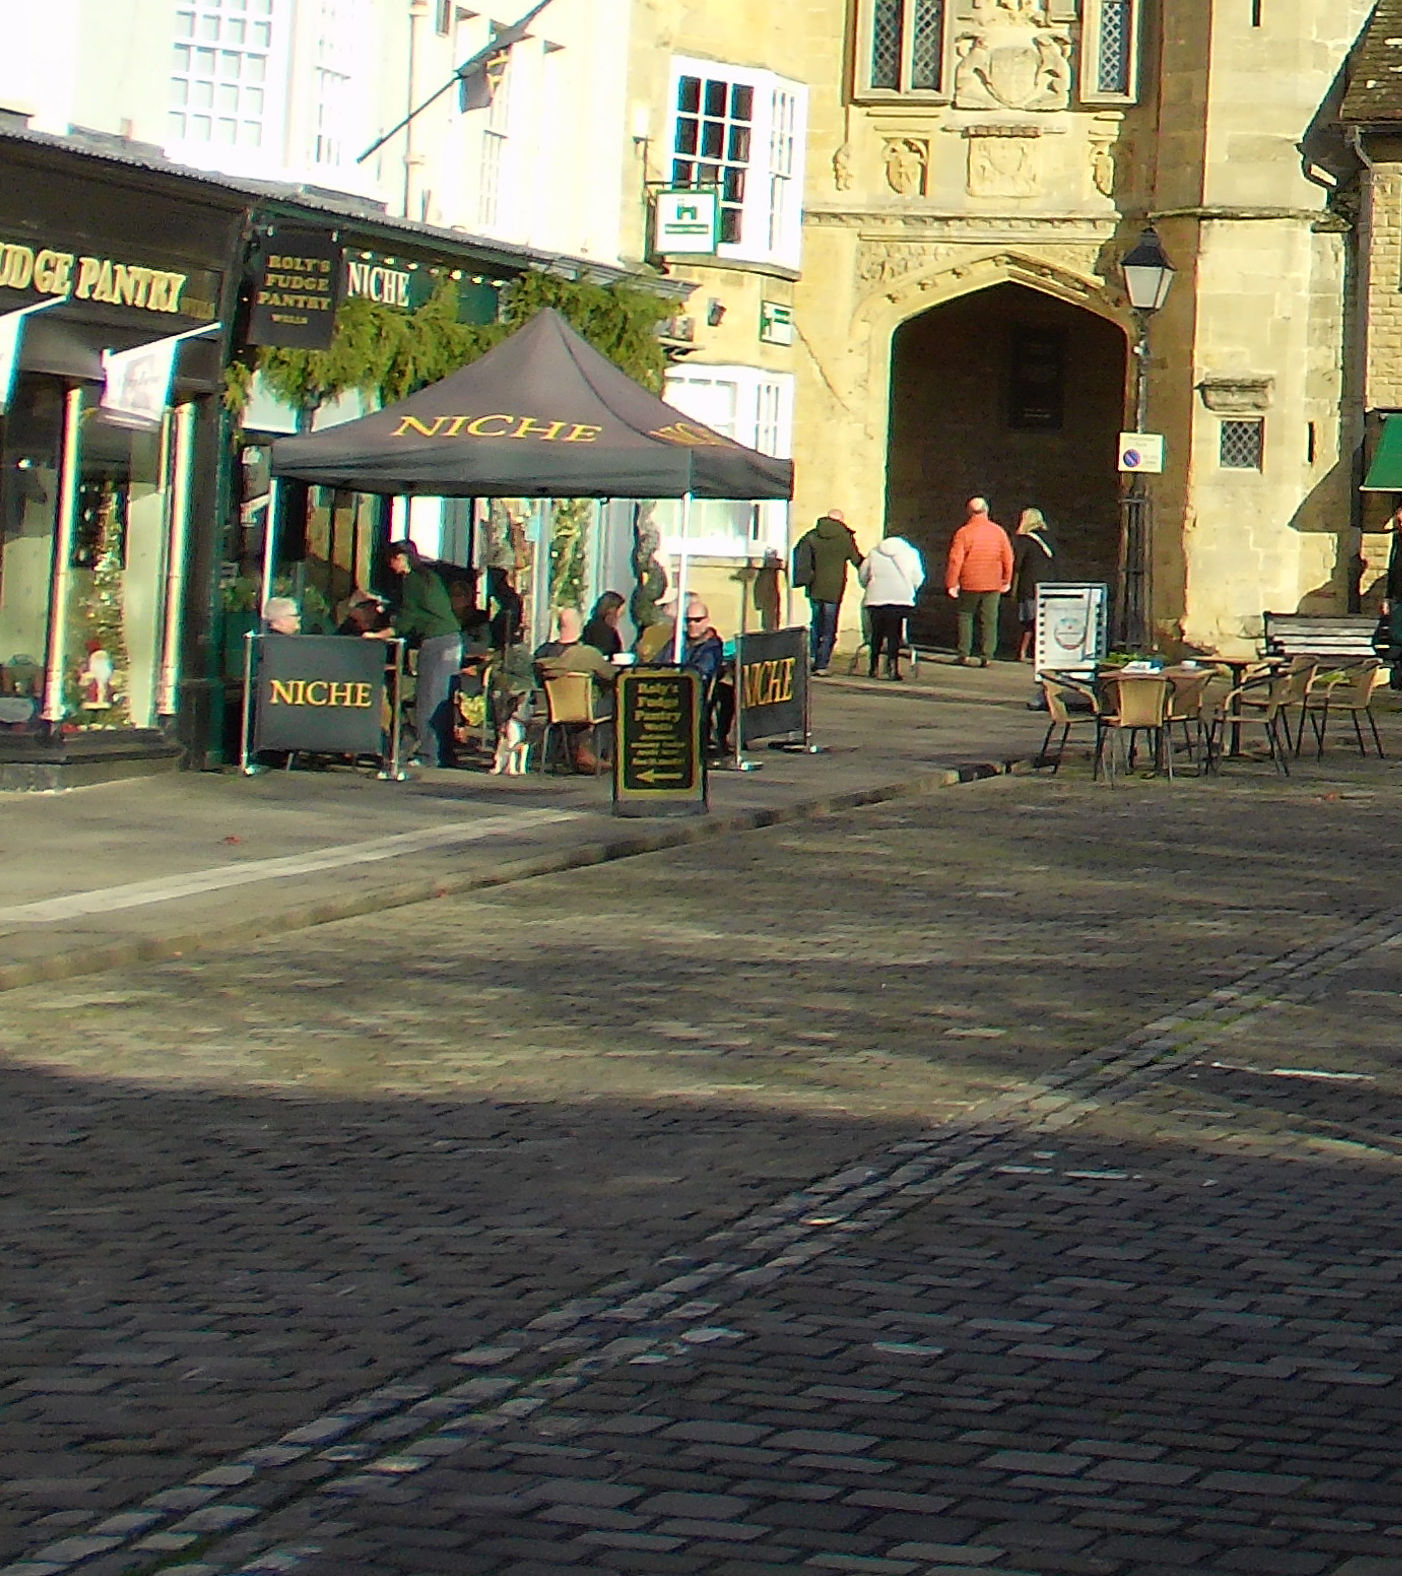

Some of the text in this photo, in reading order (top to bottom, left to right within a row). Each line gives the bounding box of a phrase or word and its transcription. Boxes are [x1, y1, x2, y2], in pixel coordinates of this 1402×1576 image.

[75, 257, 186, 313] PANTRY
[264, 273, 330, 292] FUDGE
[347, 261, 410, 307] NICHE
[257, 291, 332, 311] PANTRY
[389, 413, 603, 442] NICHE
[268, 679, 373, 708] NICHE
[741, 657, 797, 709] NICHE
